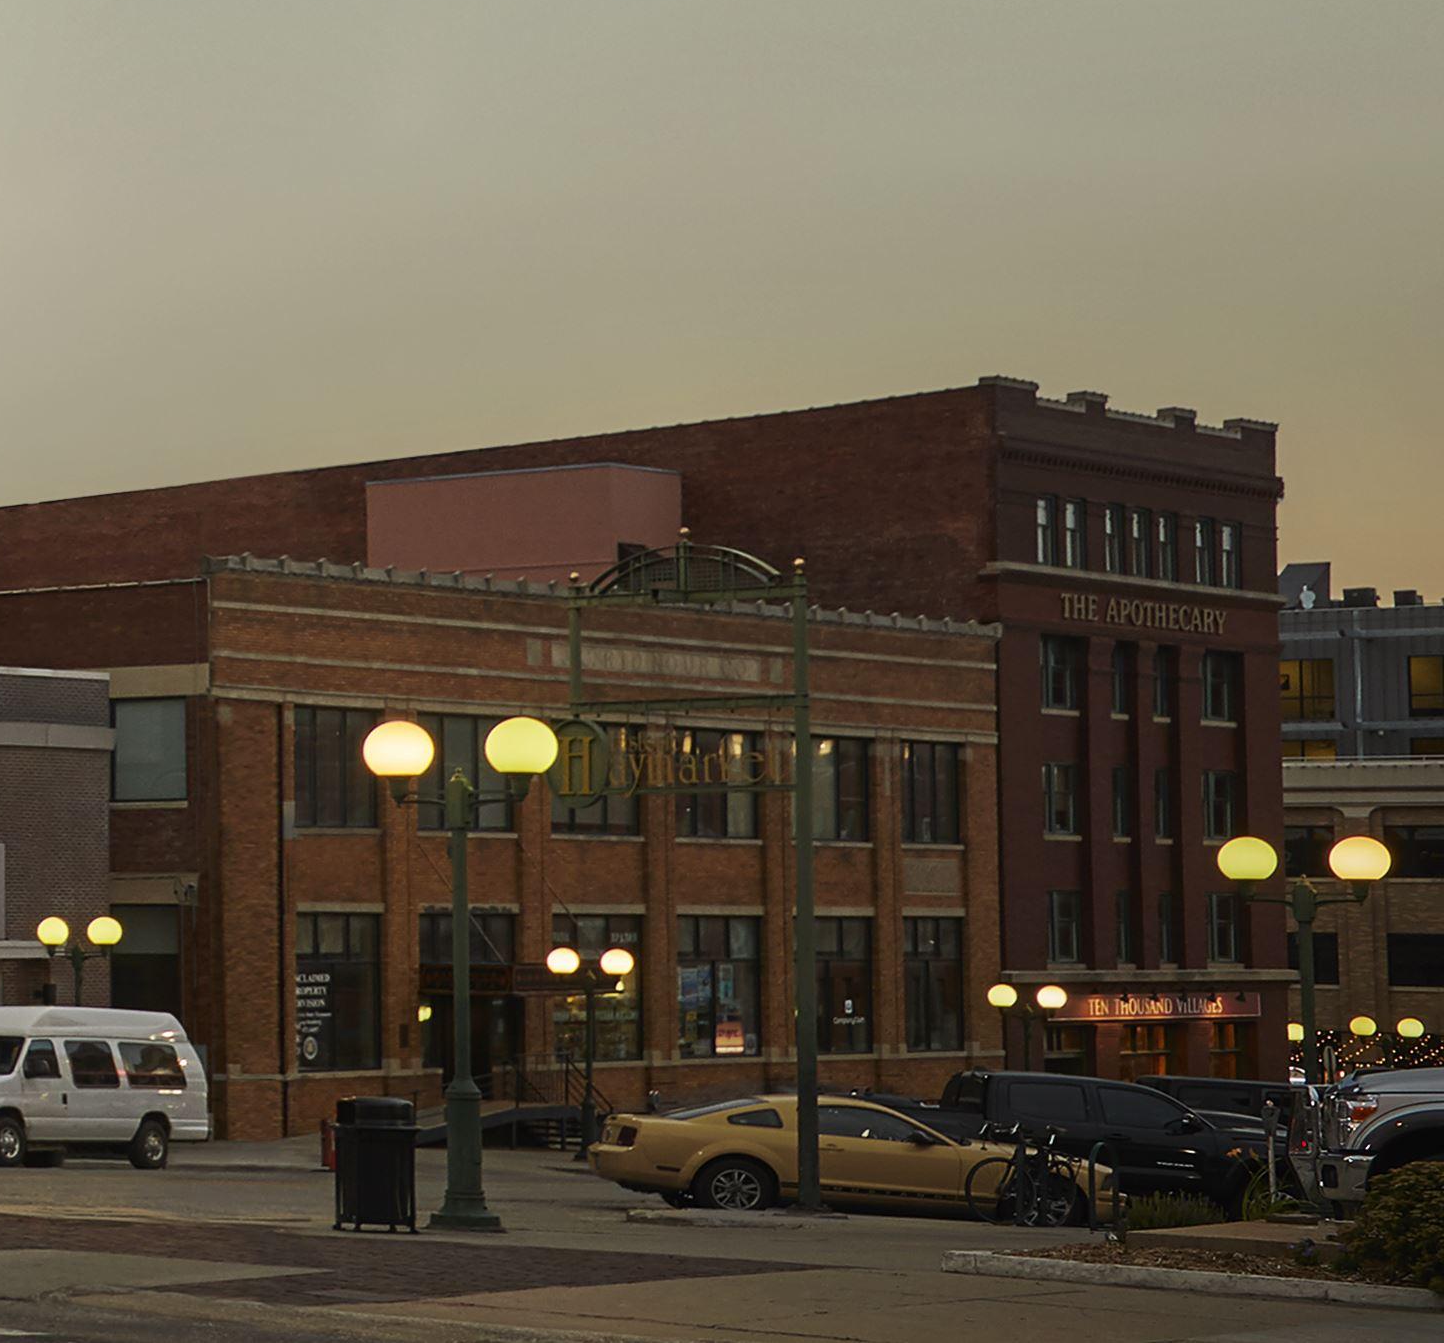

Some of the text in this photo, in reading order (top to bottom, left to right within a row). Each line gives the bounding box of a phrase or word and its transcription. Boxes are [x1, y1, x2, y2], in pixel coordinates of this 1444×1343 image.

[1061, 593, 1227, 634] THE APOTHECARY
[1089, 999, 1108, 1015] TEN
[1115, 998, 1172, 1015] THOUSAND
